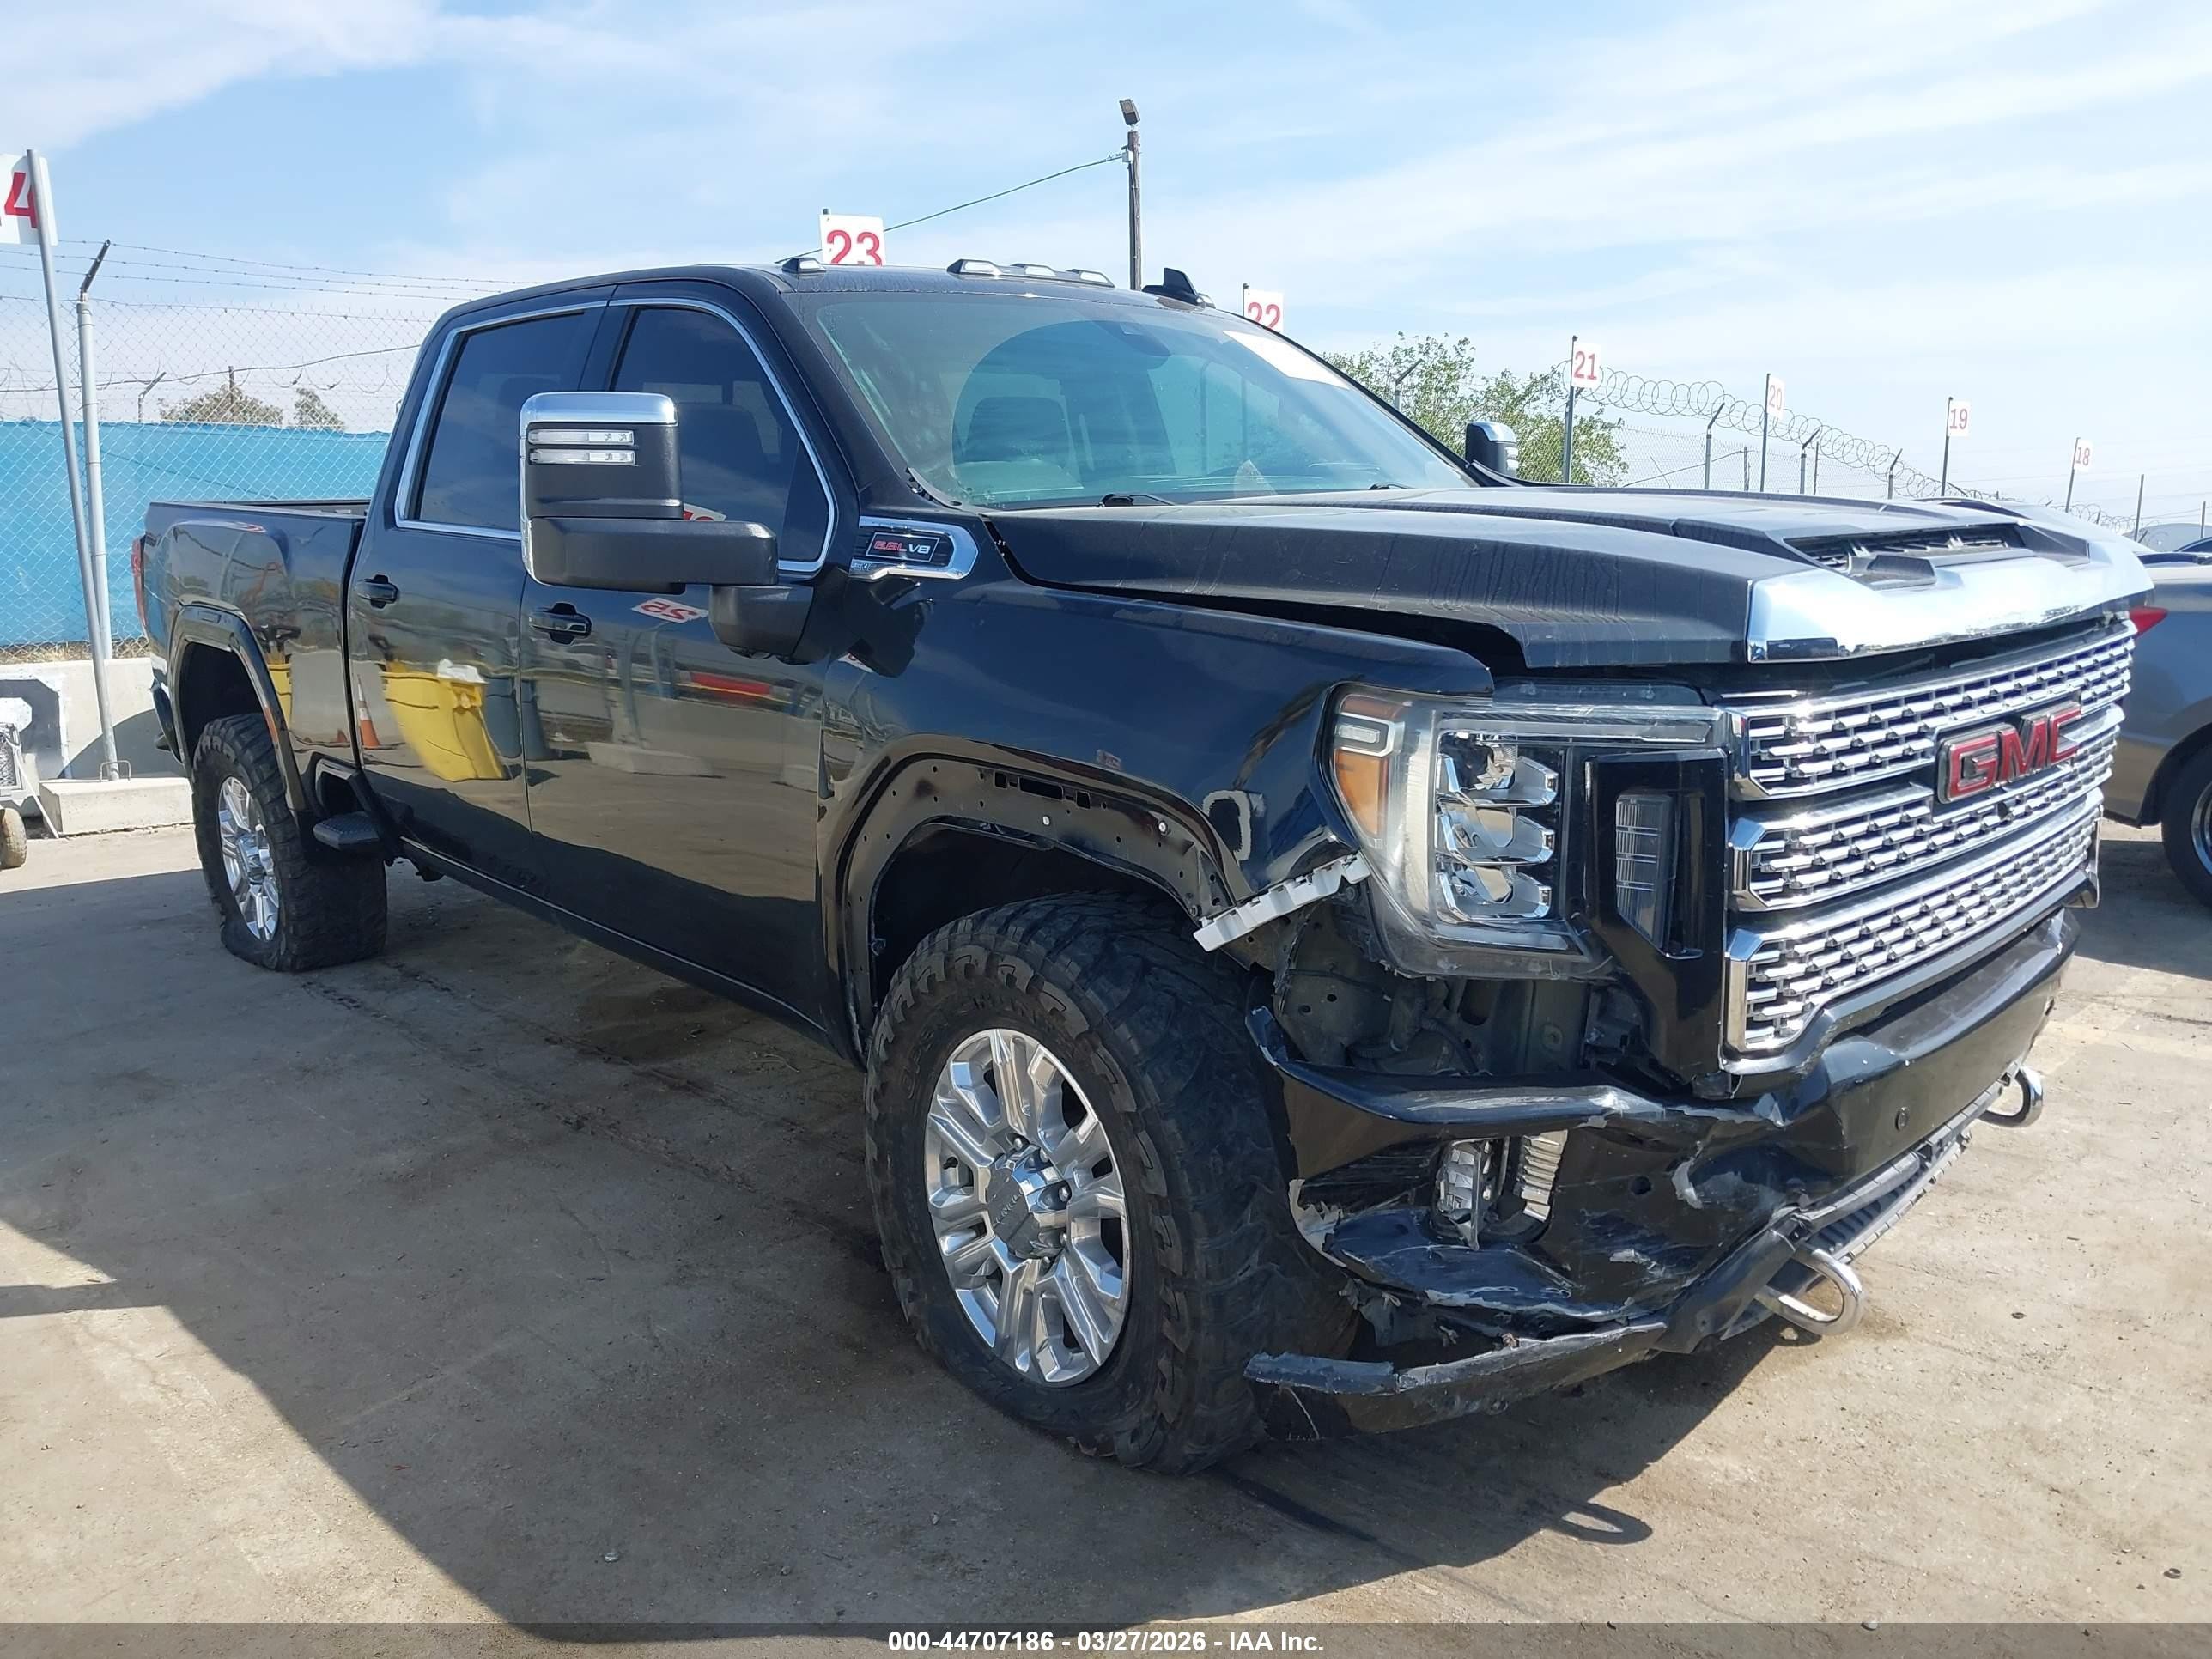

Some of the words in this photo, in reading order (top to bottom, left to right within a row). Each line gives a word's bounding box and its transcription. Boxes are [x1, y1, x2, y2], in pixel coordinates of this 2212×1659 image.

[0, 172, 39, 228] 4
[827, 230, 882, 266] 23
[1248, 302, 1280, 328] 22
[1574, 350, 1597, 380] 21
[1769, 385, 1782, 411] 20
[1950, 409, 1967, 429] 19
[2075, 447, 2090, 465] 18
[908, 543, 931, 555] V8
[1944, 701, 2081, 803] GMC
